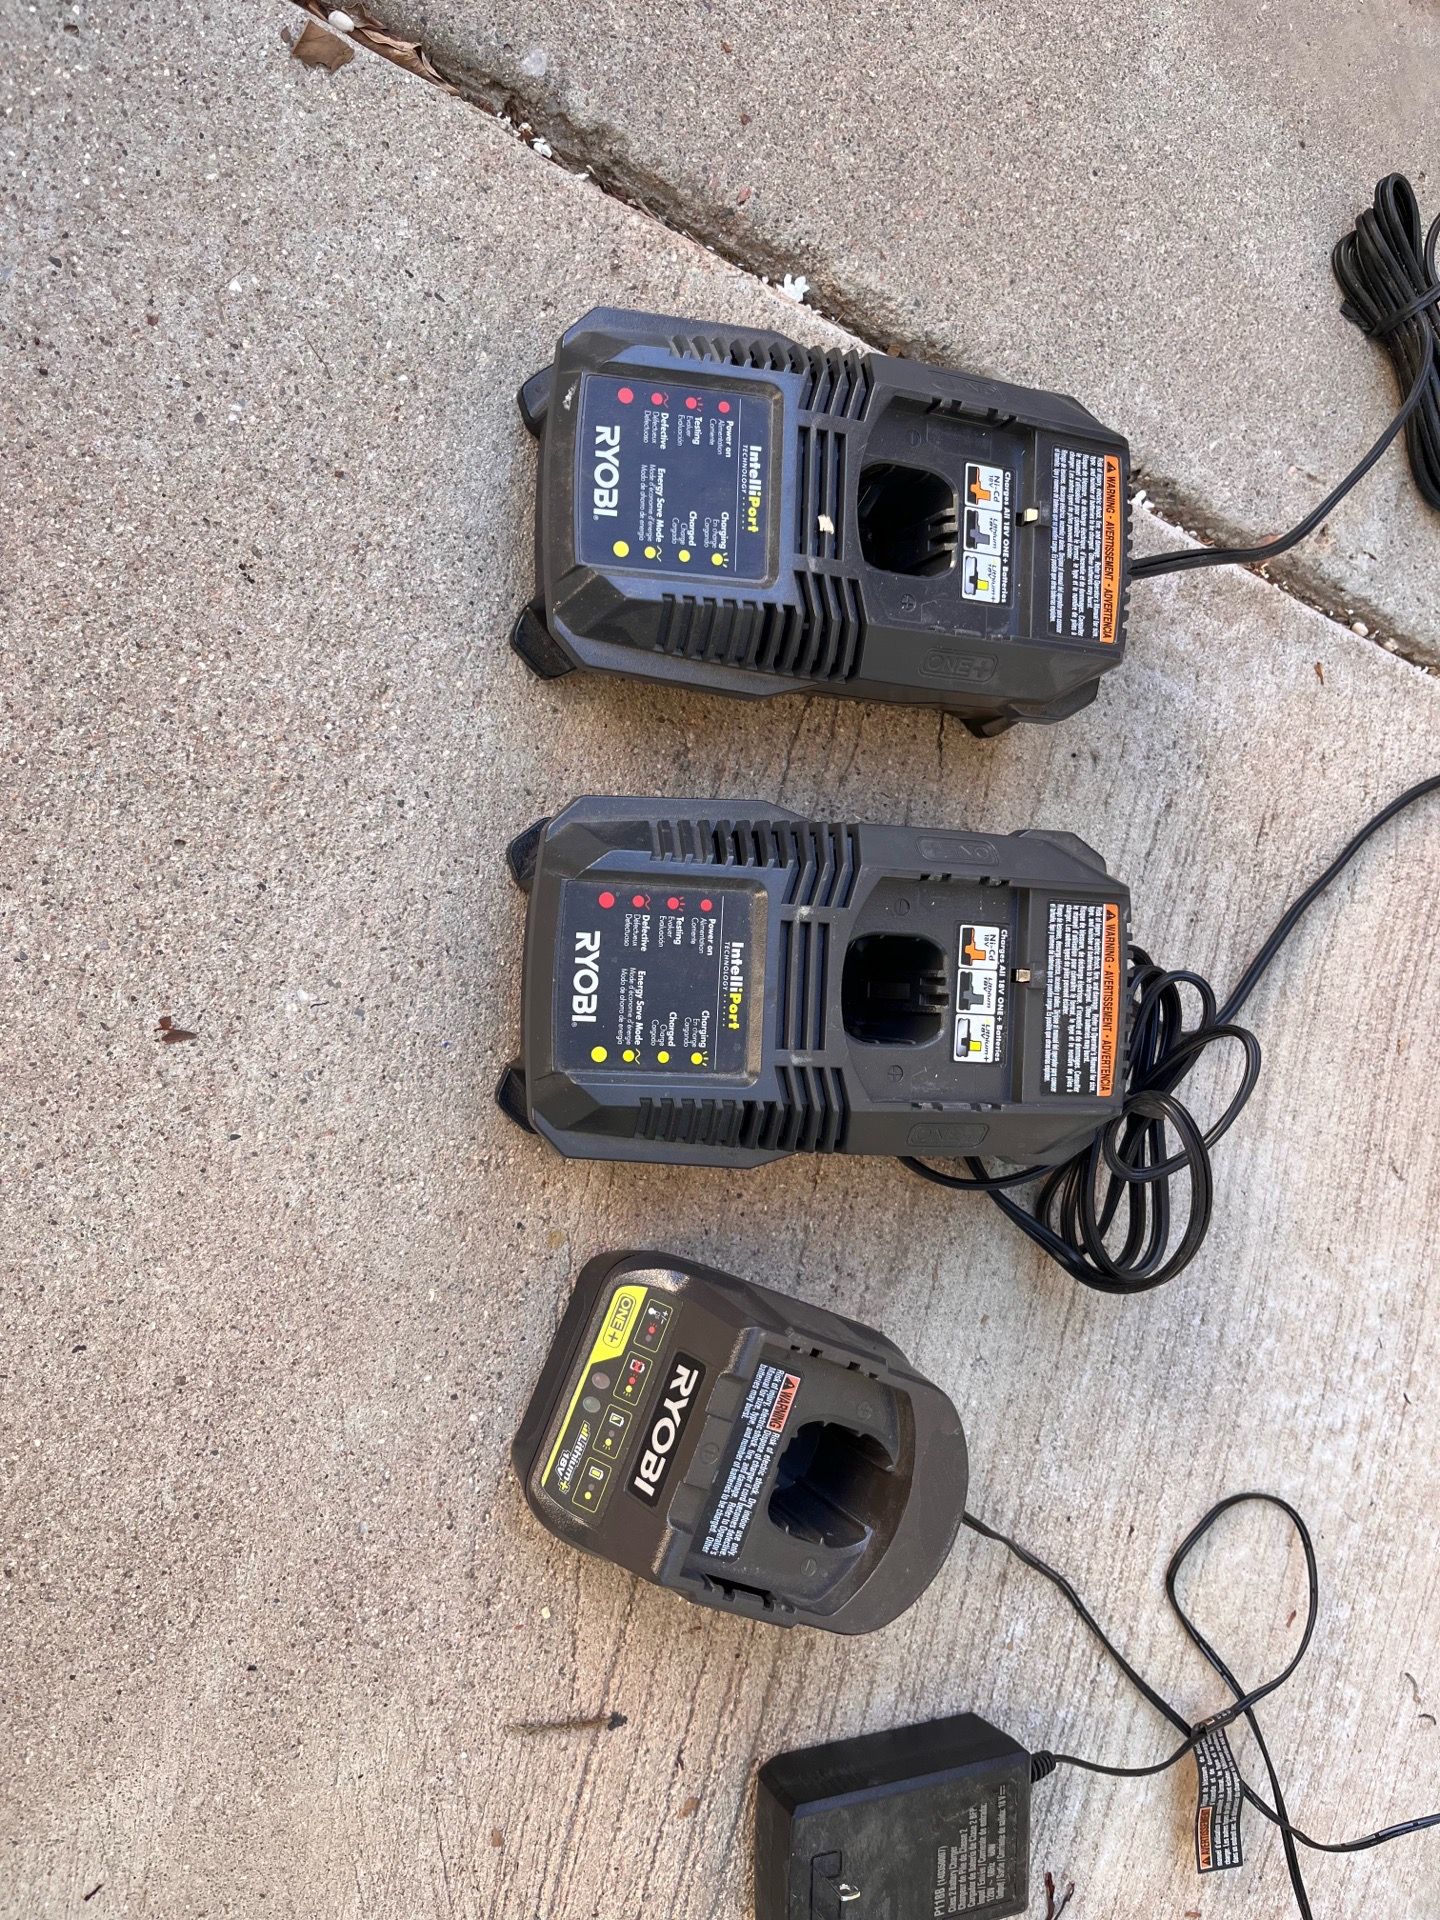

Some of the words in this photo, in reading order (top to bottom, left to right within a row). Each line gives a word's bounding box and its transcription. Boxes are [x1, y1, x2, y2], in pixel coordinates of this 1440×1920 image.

[660, 413, 668, 449] Defective
[692, 417, 702, 445] Testing
[725, 420, 733, 445] Power
[726, 448, 732, 458] on
[641, 482, 646, 491] de
[655, 468, 665, 495] Energy
[748, 445, 762, 532] IntelliPort
[1003, 472, 1011, 505] Charges
[1106, 476, 1115, 514] WARNING
[640, 511, 646, 519] de
[713, 519, 718, 527] En
[671, 518, 679, 544] Cargado
[687, 511, 696, 546] Charged
[719, 512, 728, 549] Charging
[1104, 521, 1115, 581] AVERTISSEMENT
[1103, 588, 1113, 638] ADVERTENCIA
[624, 914, 632, 946] Defectuoso
[641, 915, 649, 951] Defective
[674, 917, 684, 944] Testing
[707, 919, 715, 944] Power
[707, 946, 714, 956] on
[998, 930, 1007, 963] Charges
[1105, 924, 1115, 963] WARNING
[620, 968, 628, 986] Modo
[722, 942, 730, 990] TECHNOLOGY
[635, 971, 646, 999] Energy
[729, 942, 744, 1029] IntelliPort
[636, 1001, 644, 1020] Save
[996, 997, 1004, 1021] ONE+
[1103, 971, 1113, 1032] AVERTISSEMENT
[635, 1022, 643, 1045] Mode
[650, 1020, 658, 1046] Cargado
[667, 1012, 677, 1046] Charged
[683, 1017, 691, 1047] Cargando
[693, 1018, 699, 1027] En
[699, 1010, 710, 1048] Charging
[995, 1025, 1003, 1062] Batteries
[1101, 1040, 1111, 1092] ADVERTENCIA
[608, 1298, 632, 1342] ONE+
[752, 1364, 768, 1389] batteries
[763, 1367, 776, 1388] Manual
[774, 1370, 784, 1383] Risk
[746, 1390, 757, 1402] may
[760, 1389, 768, 1397] for
[756, 1408, 769, 1430] electric
[770, 1391, 792, 1428] WARNING
[634, 1364, 699, 1496] RYOBI
[744, 1427, 753, 1439] and
[757, 1430, 771, 1452] Dispose
[769, 1432, 780, 1446] Risk
[736, 1439, 749, 1461] number
[557, 1450, 570, 1477] 18V
[559, 1434, 590, 1493] Lithium+
[740, 1462, 749, 1474] and
[746, 1460, 760, 1482] charger
[758, 1454, 771, 1476] electric
[724, 1468, 738, 1494] batteries
[718, 1500, 727, 1508] be
[739, 1489, 749, 1502] cord
[743, 1498, 756, 1509] Dry
[724, 1502, 736, 1518] Refer
[729, 1502, 744, 1528] becomes
[739, 1510, 752, 1530] indoor
[702, 1537, 714, 1553] Other
[719, 1529, 735, 1556] defective.
[734, 1530, 743, 1541] use
[728, 1543, 738, 1556] only.
[934, 1888, 945, 1916] P118B
